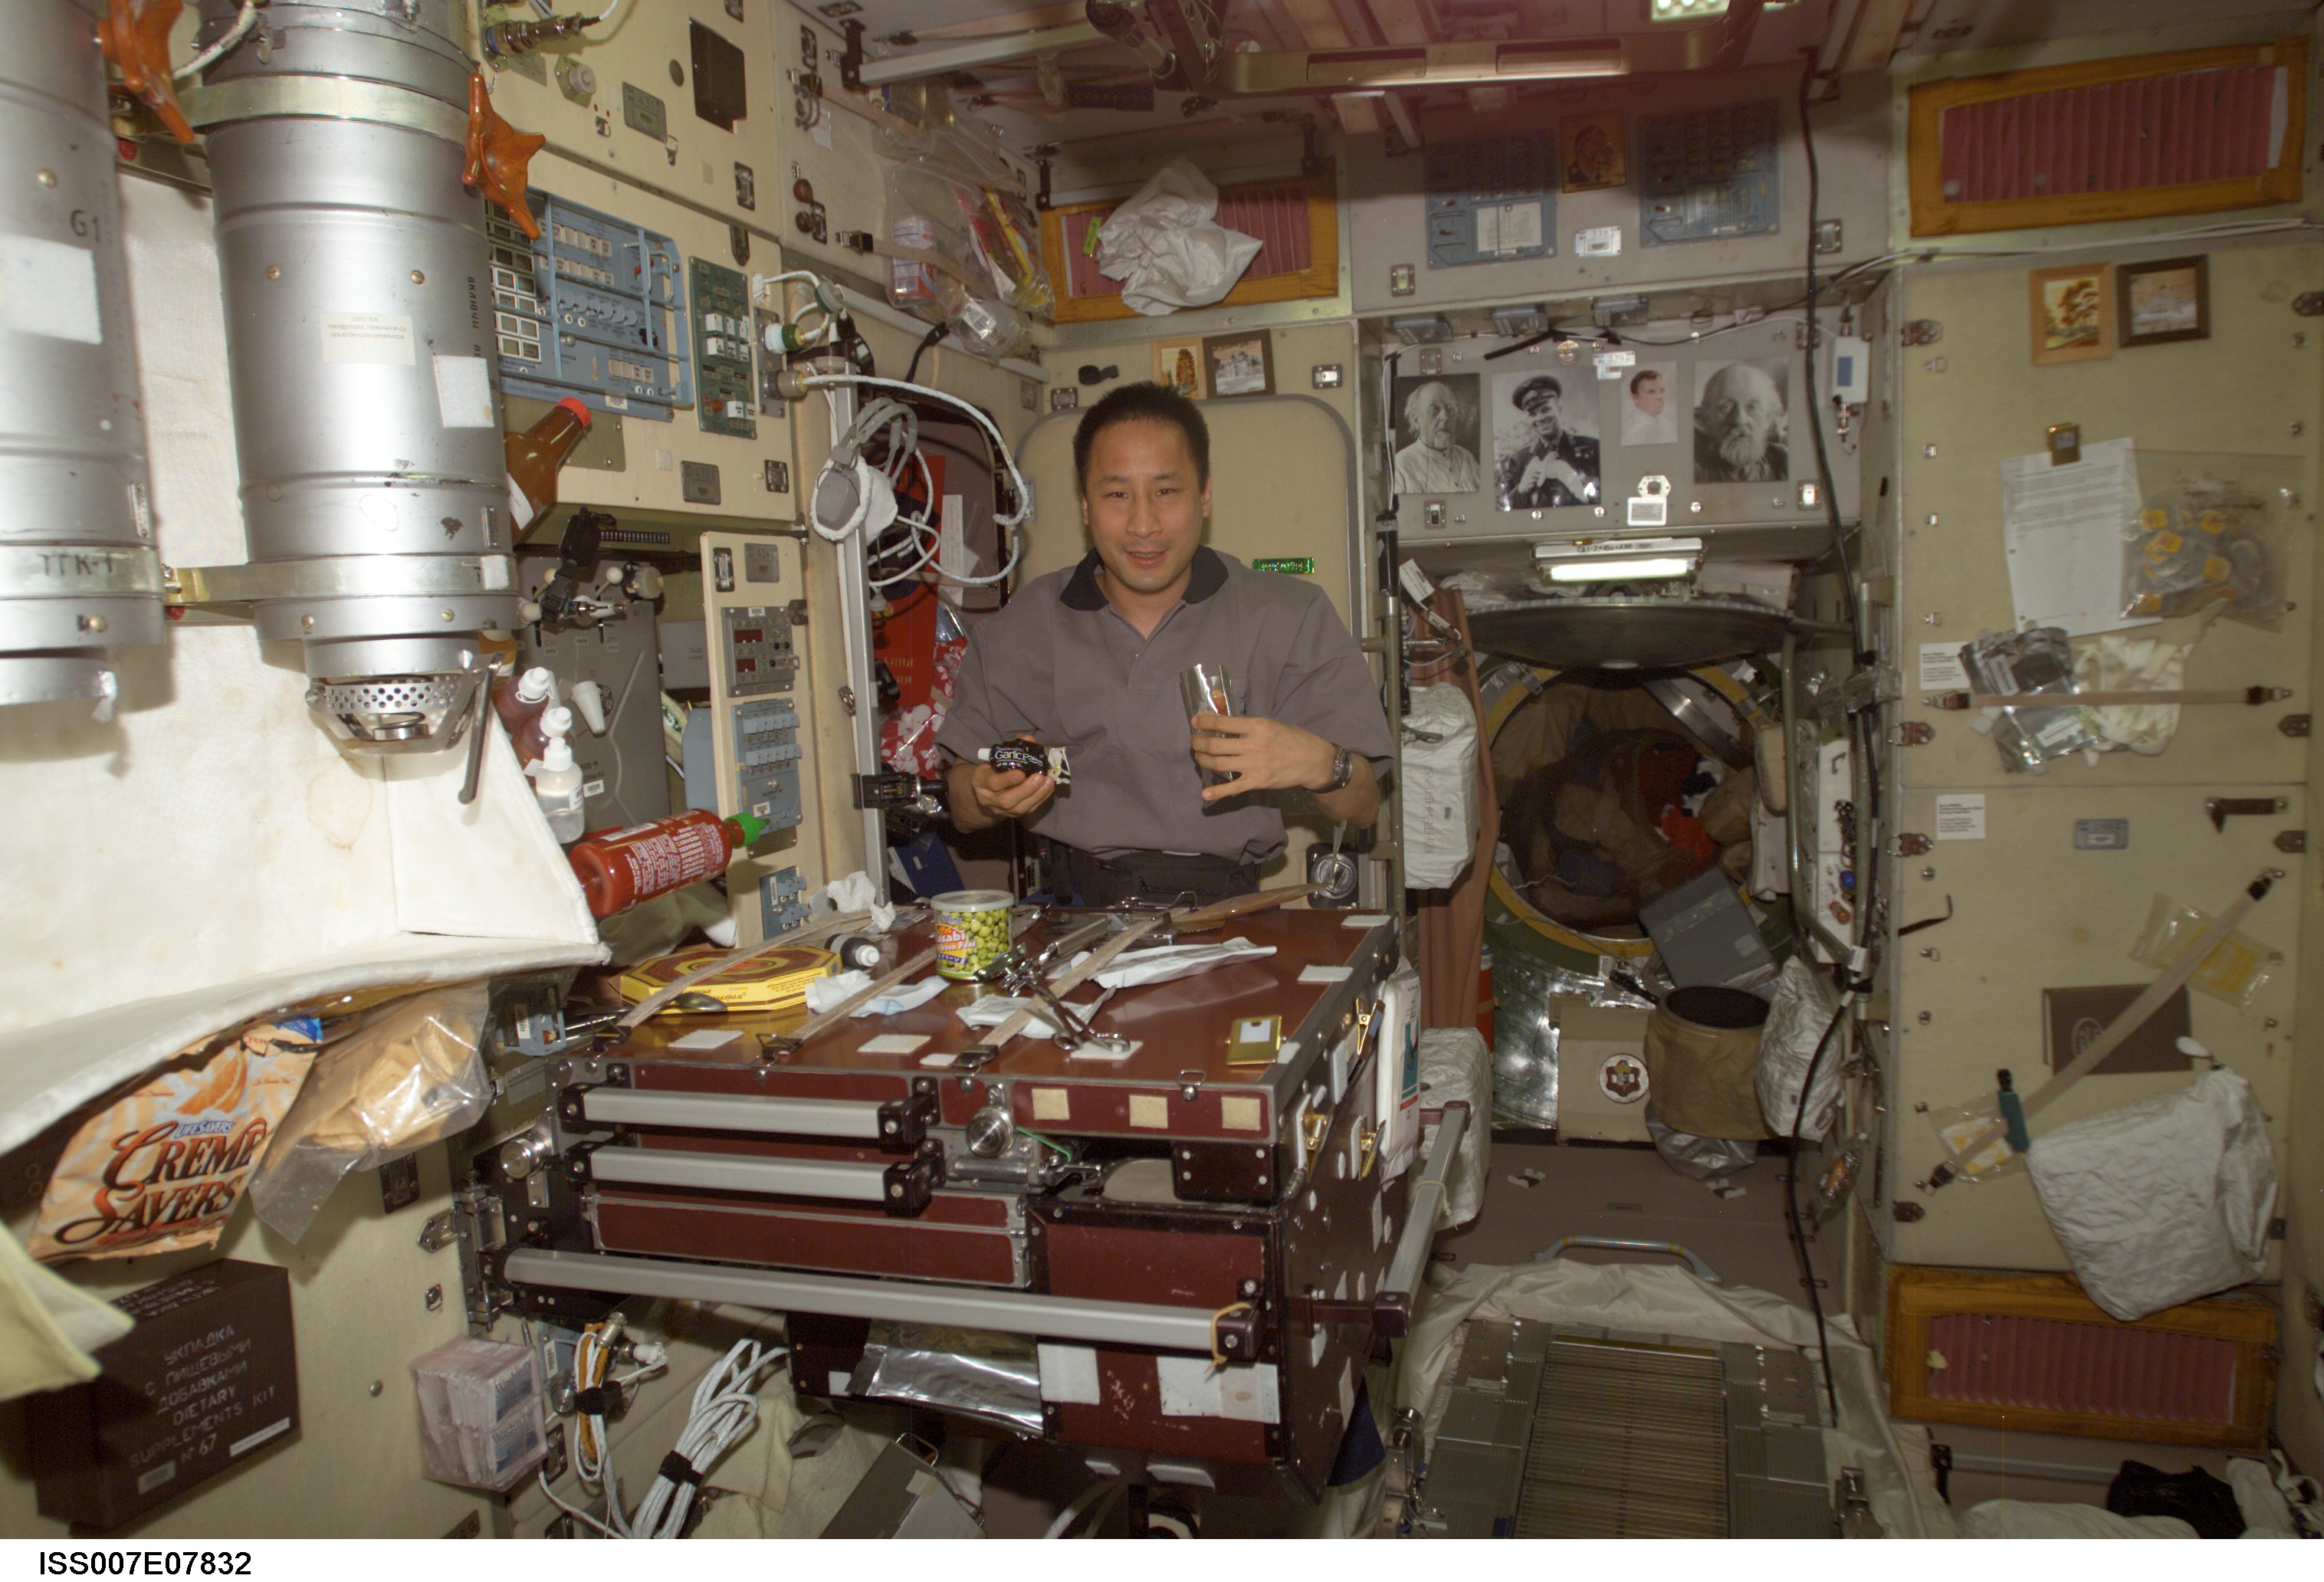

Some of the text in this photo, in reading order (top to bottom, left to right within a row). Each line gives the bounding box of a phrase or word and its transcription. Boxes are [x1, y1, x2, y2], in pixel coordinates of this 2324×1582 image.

[995, 750, 1022, 760] Garlic
[937, 929, 966, 944] asabi
[166, 1338, 252, 1387] ПИЩЕВЫМИ
[156, 1360, 248, 1416] ДОБАВКАМИ
[173, 1385, 237, 1427] DIETARY
[130, 1385, 276, 1468] SUPPLEMENTS KIT
[198, 1432, 218, 1457] 67
